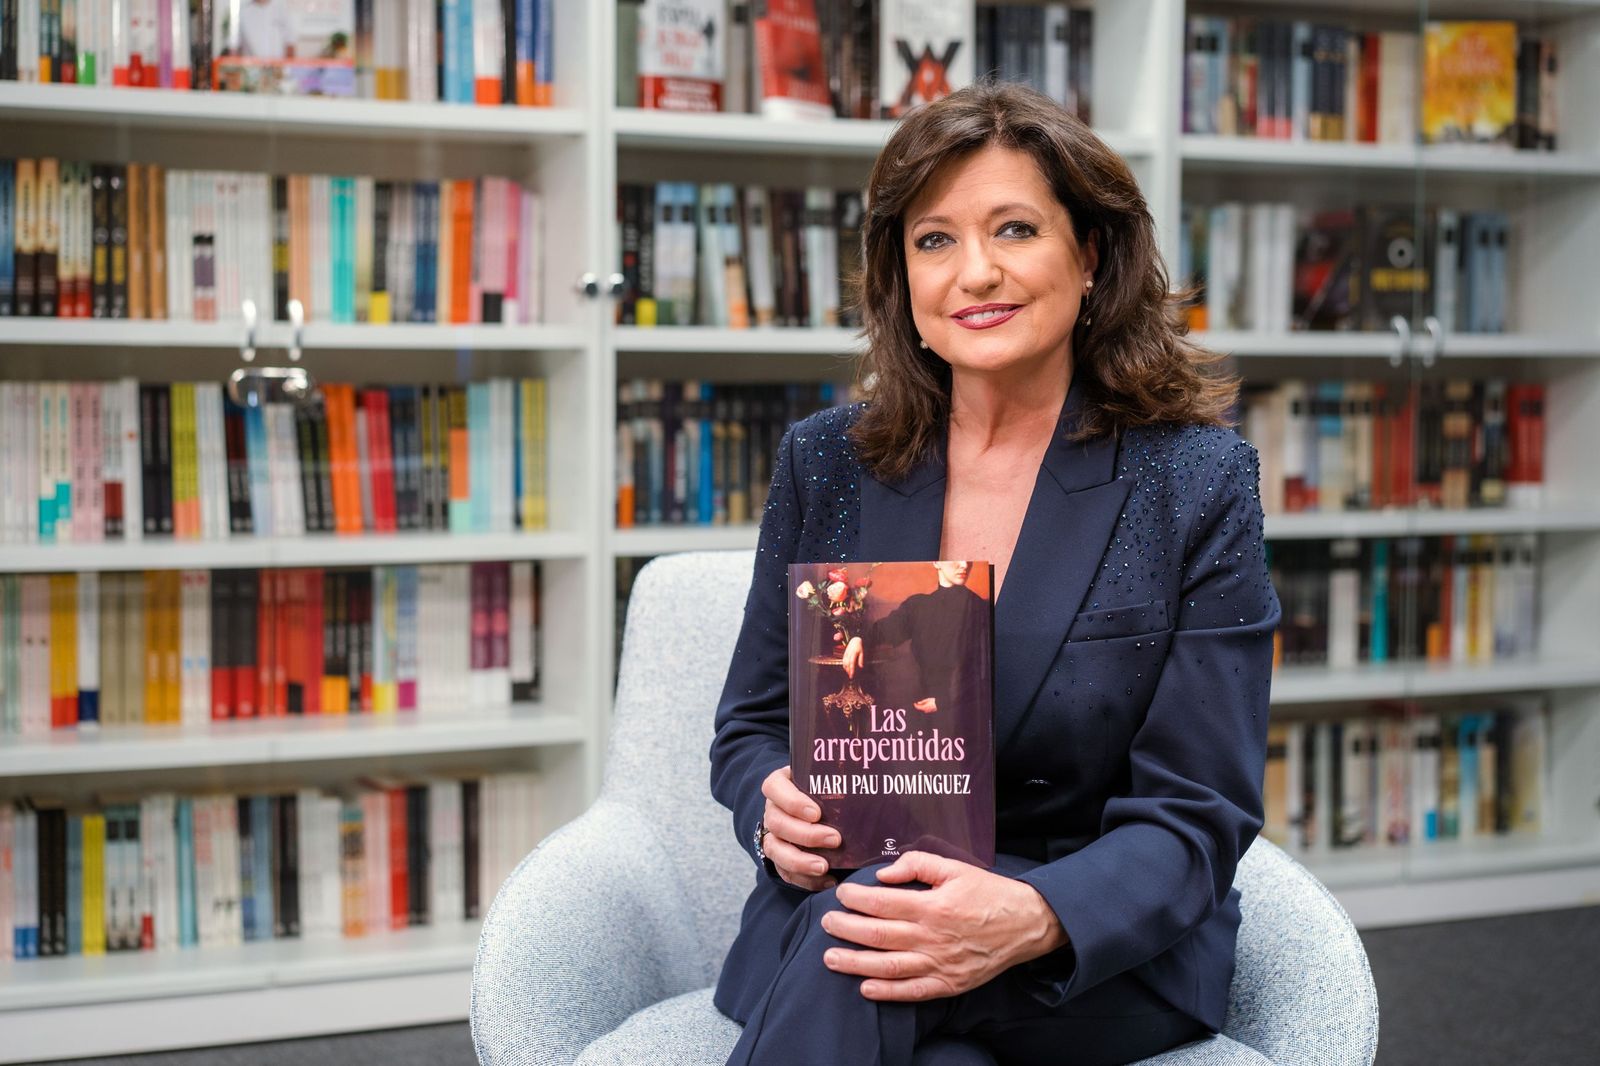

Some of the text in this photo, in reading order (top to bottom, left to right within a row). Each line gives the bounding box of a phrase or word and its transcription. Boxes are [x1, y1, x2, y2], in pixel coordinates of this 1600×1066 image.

[870, 705, 906, 732] Las
[814, 729, 965, 769] arrepentidas
[809, 770, 971, 795] MARI PAU DOMÍNGUEZ
